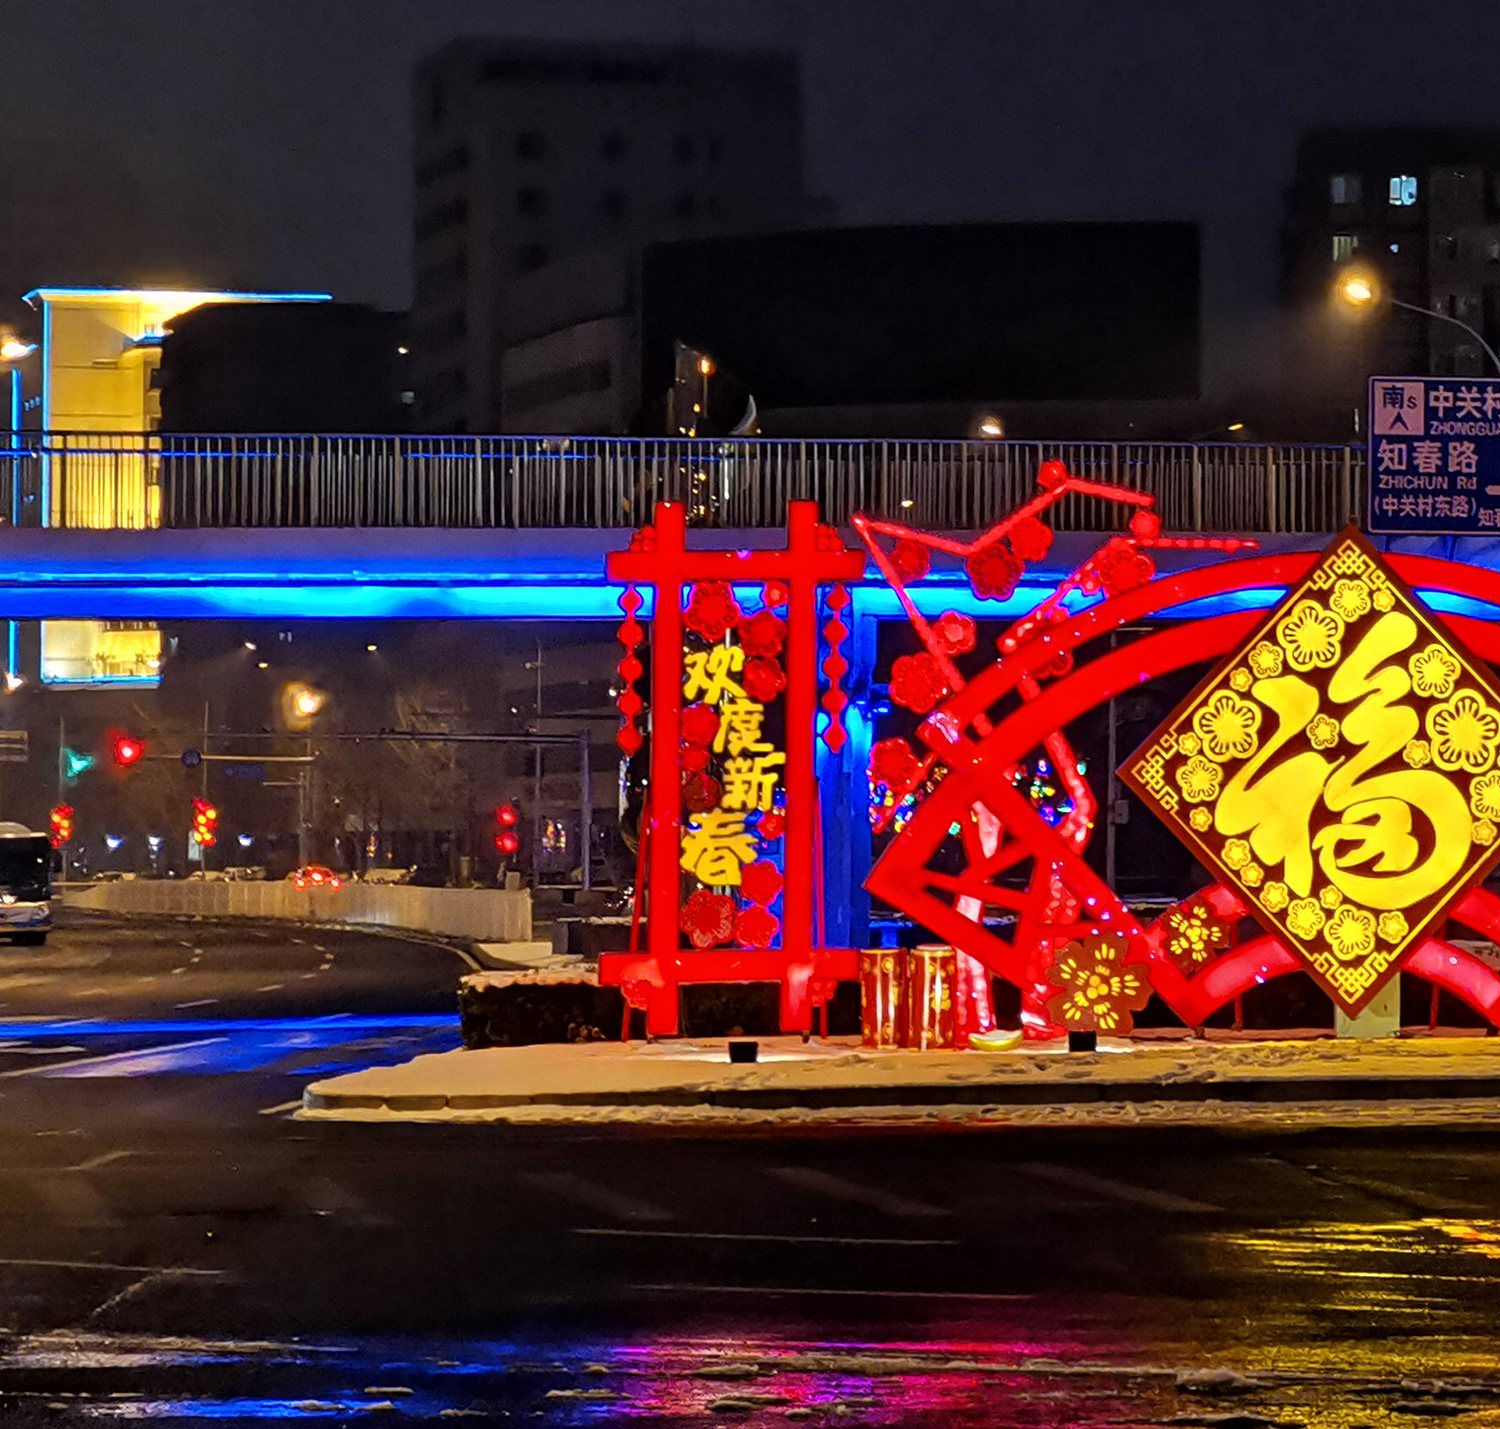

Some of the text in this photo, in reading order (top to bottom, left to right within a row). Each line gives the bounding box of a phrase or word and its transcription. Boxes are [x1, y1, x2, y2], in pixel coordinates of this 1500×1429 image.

[1381, 385, 1405, 409] 南
[1406, 396, 1418, 409] S
[1377, 439, 1479, 473] 知春路
[1378, 474, 1478, 490] ZHICHUN Rd
[679, 643, 786, 886] 欢度新春
[1214, 611, 1474, 912] 福
